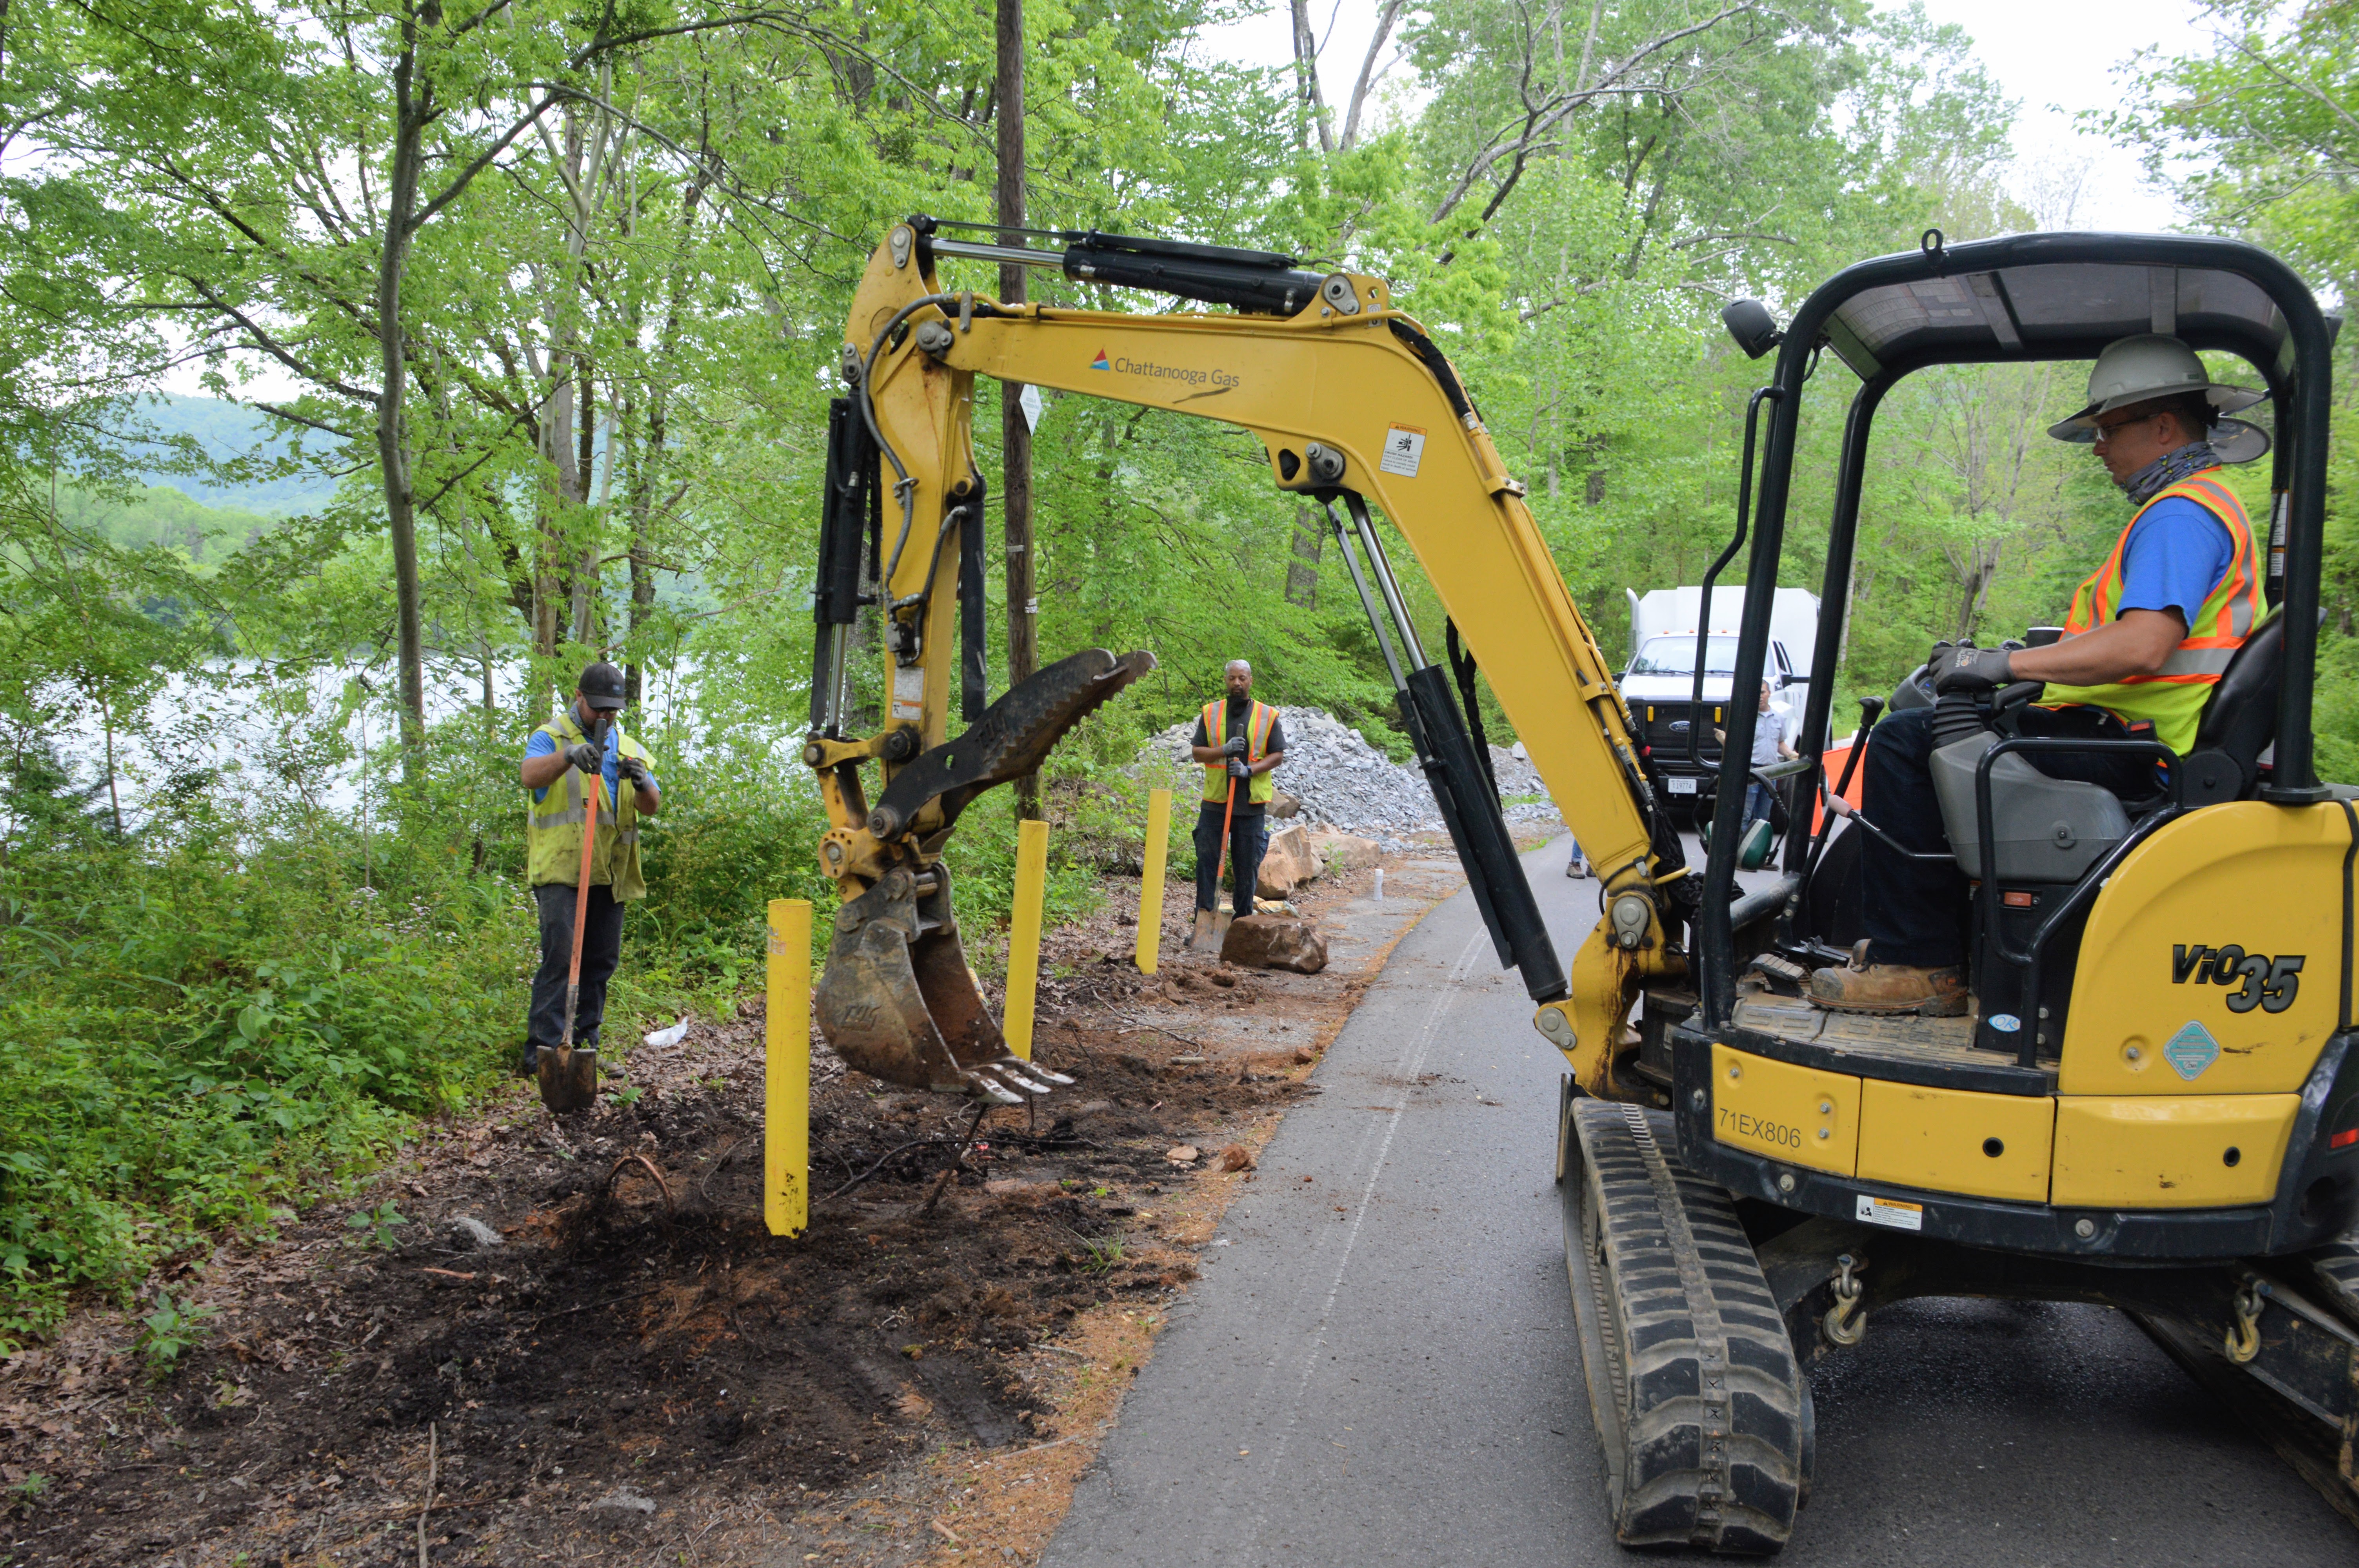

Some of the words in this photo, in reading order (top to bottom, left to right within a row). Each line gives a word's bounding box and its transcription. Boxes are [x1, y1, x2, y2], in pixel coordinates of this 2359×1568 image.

[1115, 358, 1207, 385] Chattanooga
[1211, 369, 1239, 387] Gas
[1995, 1016, 2016, 1029] OK
[1719, 1108, 1801, 1148] 71EX806
